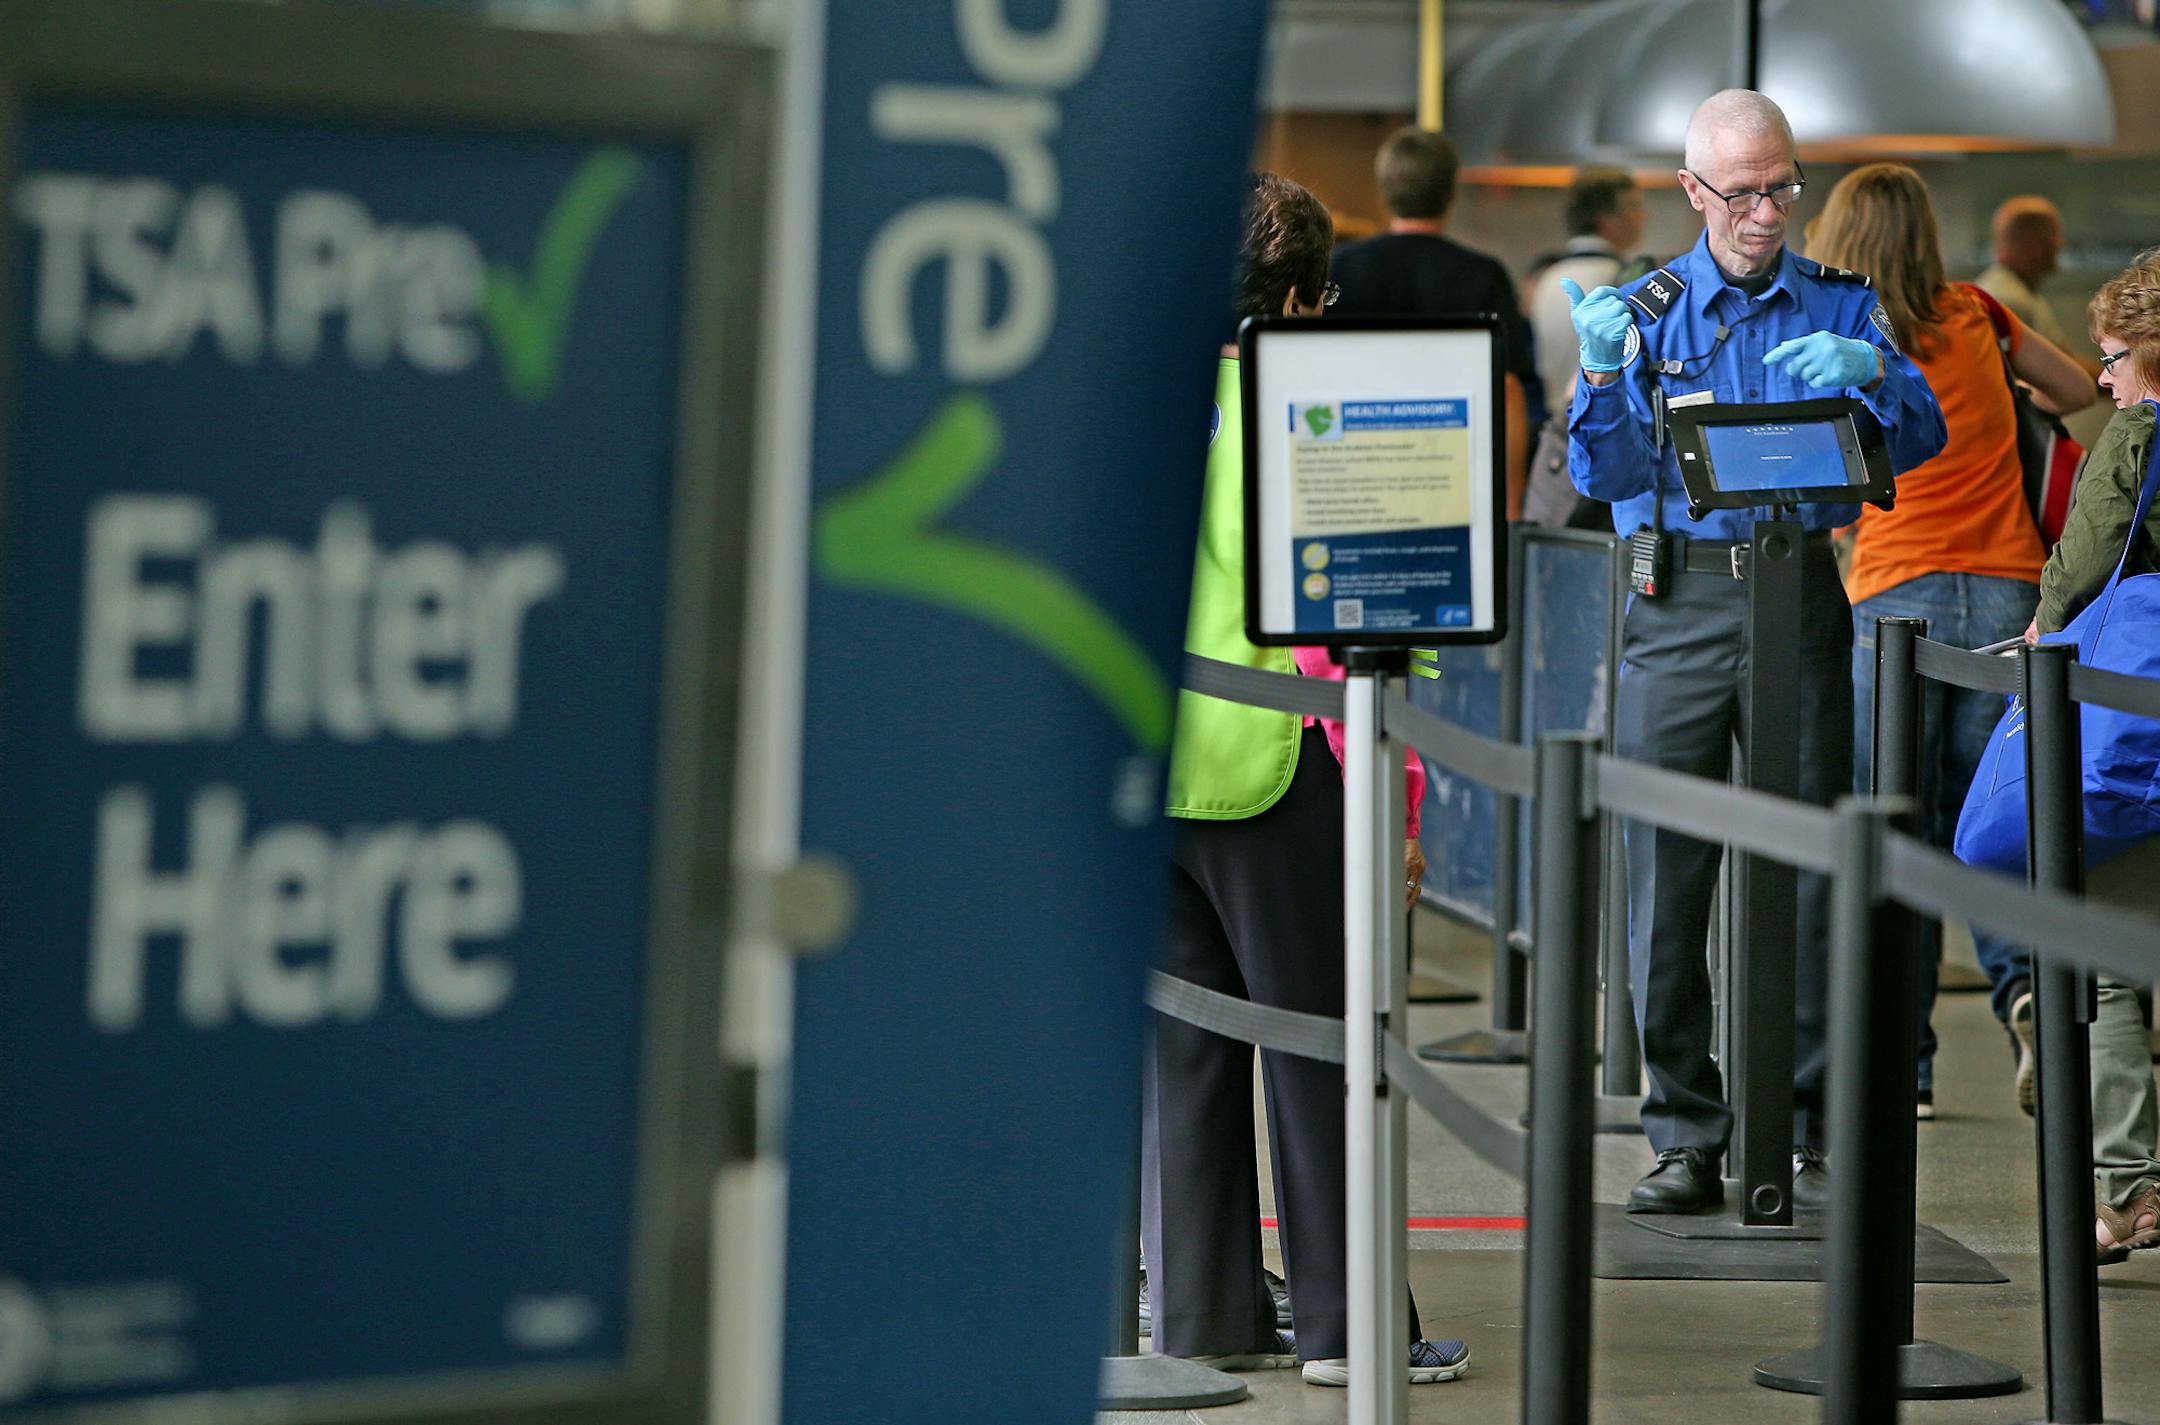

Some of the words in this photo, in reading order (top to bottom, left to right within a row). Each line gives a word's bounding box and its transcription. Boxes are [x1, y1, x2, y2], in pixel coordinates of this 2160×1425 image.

[20, 177, 265, 364] TSA
[275, 190, 485, 373] Pre
[1646, 279, 1671, 305] TSA
[80, 495, 566, 742] Enter
[88, 783, 524, 1033] Here
